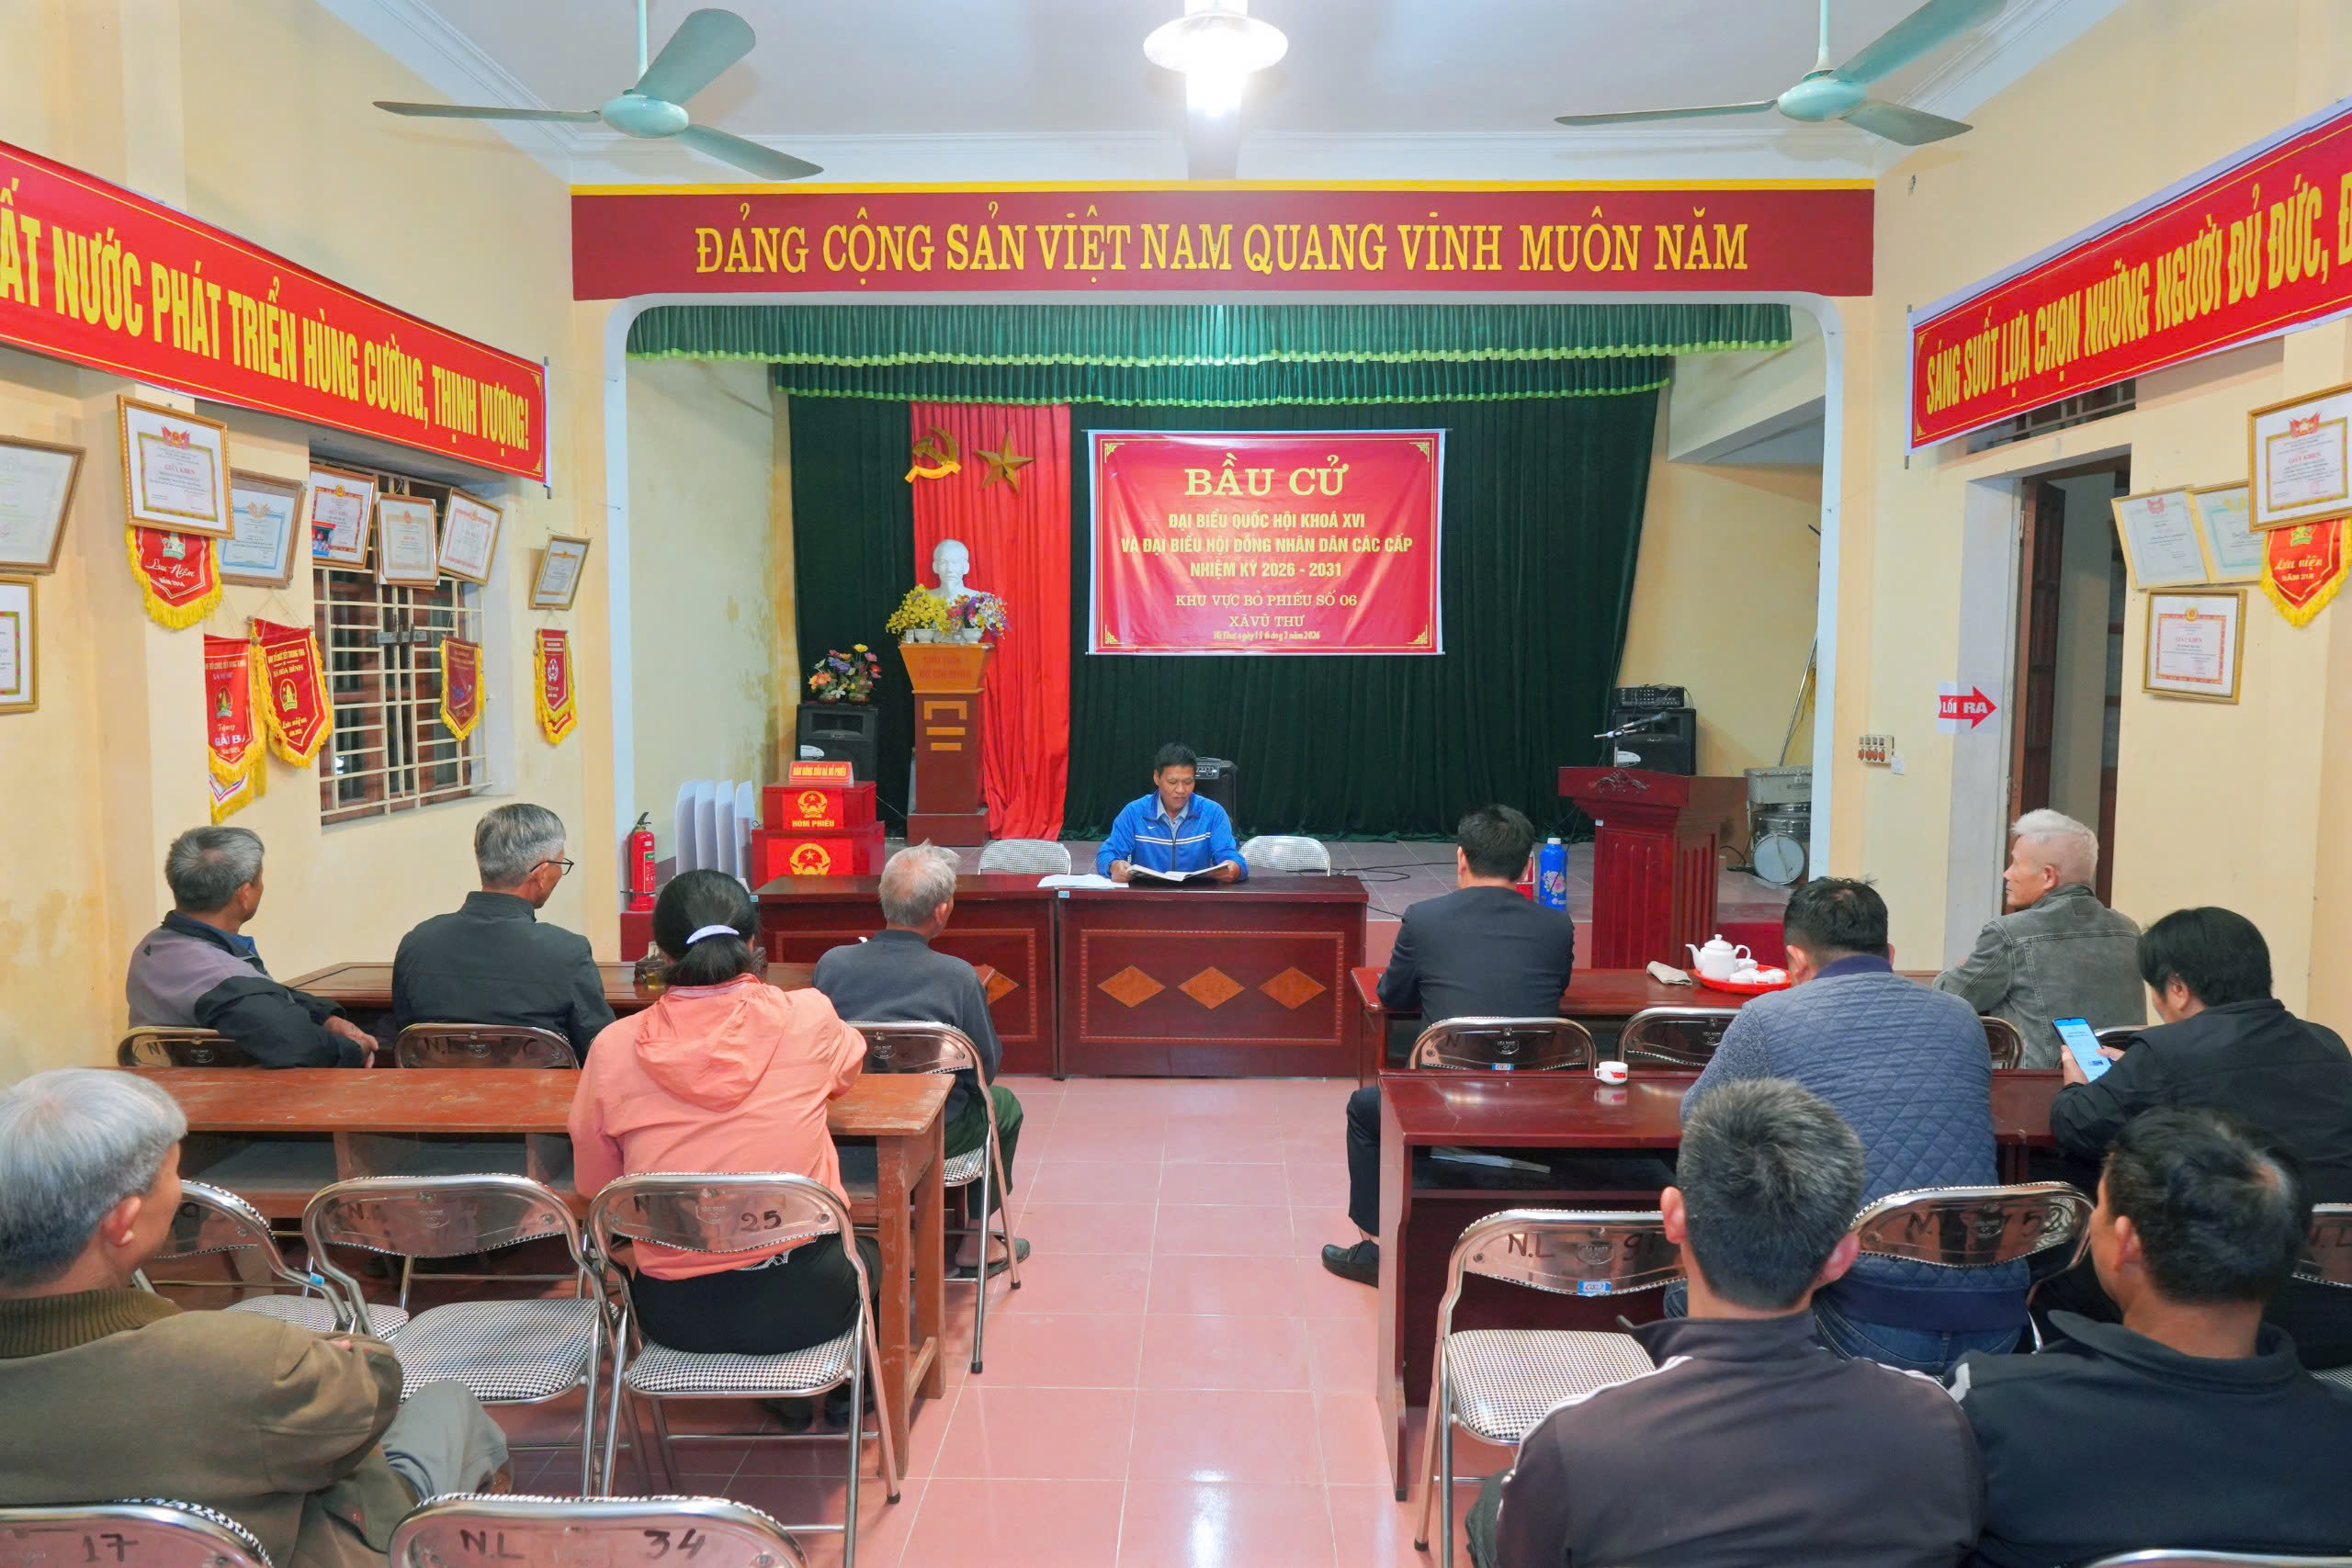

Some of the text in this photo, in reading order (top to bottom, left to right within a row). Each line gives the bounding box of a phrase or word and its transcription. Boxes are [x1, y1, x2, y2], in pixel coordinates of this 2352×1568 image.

[696, 200, 1748, 285] ĐẢNG CỘNG SẢN VIỆT NAM QUANG VINH MUÔN NĂM
[1927, 340, 1961, 415] SÁNG
[1963, 306, 2000, 401] SUỐT
[2001, 310, 2030, 398] LỰA
[2034, 292, 2081, 381] CHỌN
[2084, 260, 2149, 356] NHỮNG
[2155, 214, 2222, 332] NGƯỜI
[2227, 183, 2263, 305] ĐỦ
[2267, 173, 2329, 289] ĐỨC,
[0, 177, 529, 457] ẤT NƯỚC PHÁT TRIỂN HÙNG CƯỜNG, THỊNH VƯỢNG!
[1184, 452, 1349, 496] BẦU CỬ
[1168, 508, 1365, 531] ĐẠI BIỂU QUỐC HỘI KHOÁ XVI
[1121, 532, 1413, 556] VÀ ĐẠI BIỂU HỘI ĐỒNG NHÂN DÂN CÁC CẤP
[1190, 558, 1236, 581] NHIỆM
[1240, 559, 1258, 577] KỲ
[1261, 562, 1295, 577] 2026
[1309, 562, 1342, 577] 2031
[1175, 590, 1357, 609] KHU VỰC BỎ PHIẾU SỐ 06
[1274, 615, 1306, 627] THƯ
[1942, 697, 1987, 714] LỐI RA
[811, 818, 835, 827] PHIẾU
[741, 1210, 782, 1233] 25
[1508, 1233, 1555, 1258] N.L
[83, 1533, 139, 1562] 17
[459, 1529, 707, 1559] N.L 34
